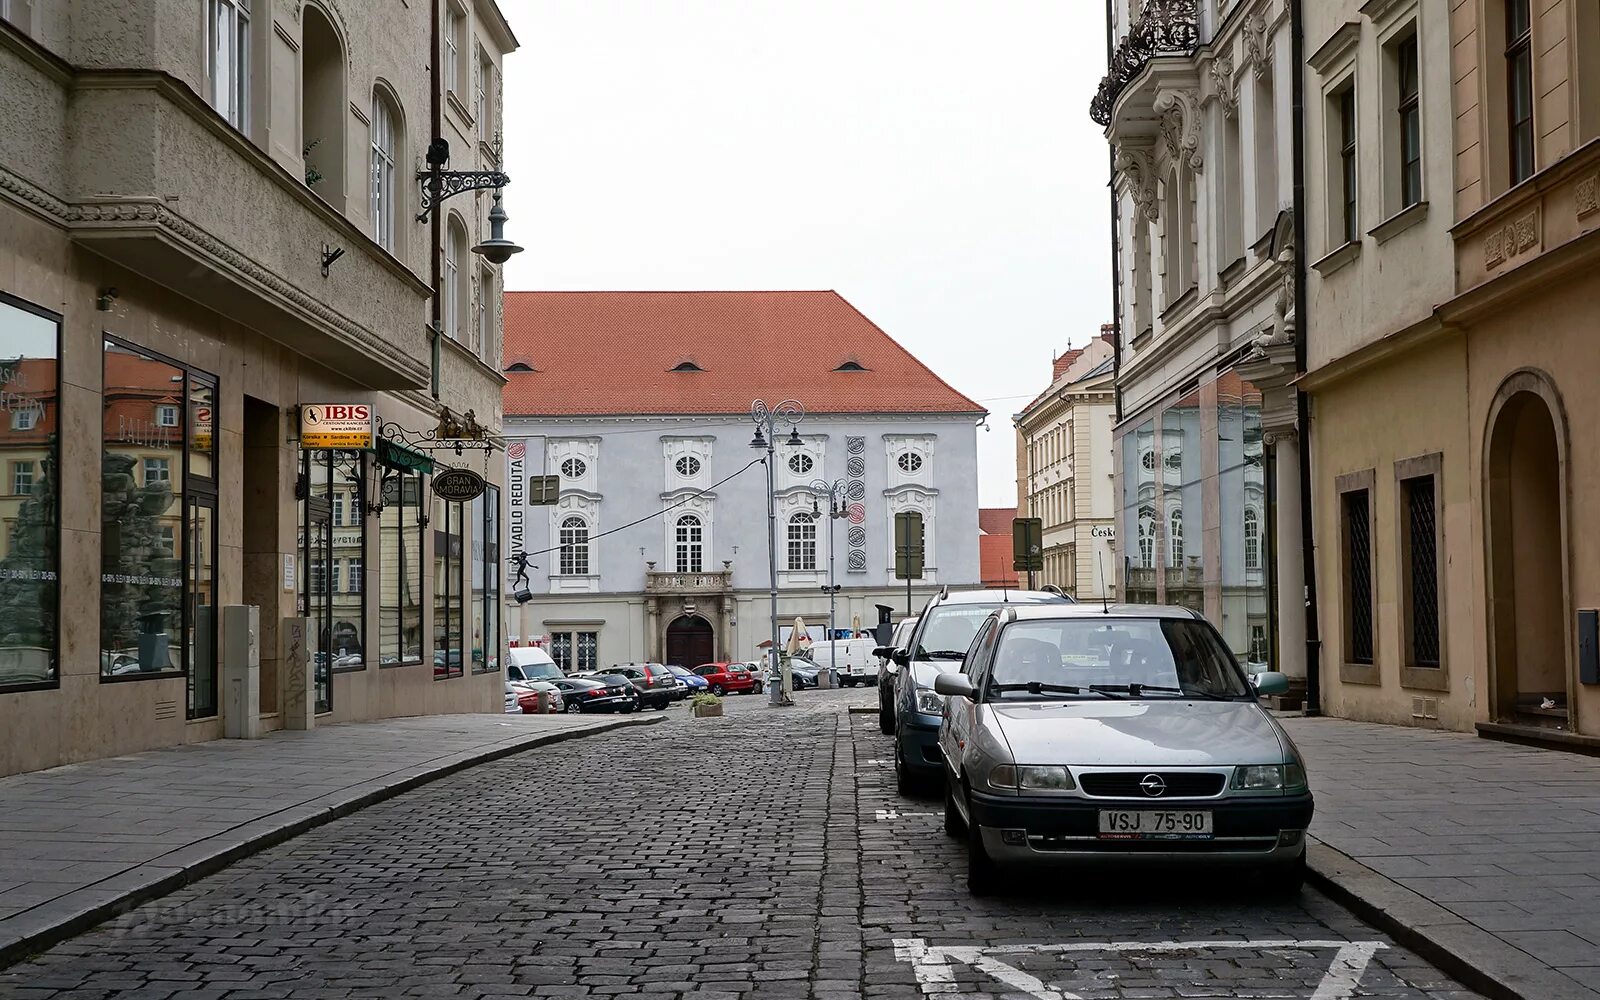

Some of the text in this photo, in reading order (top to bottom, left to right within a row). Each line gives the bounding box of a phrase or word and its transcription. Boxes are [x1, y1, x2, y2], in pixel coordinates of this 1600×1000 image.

[325, 406, 369, 420] IBIS
[446, 476, 471, 485] GRAN
[511, 460, 523, 505] REDUTA
[439, 486, 479, 494] MORAVIA
[1108, 812, 1205, 831] VSJ 75-90
